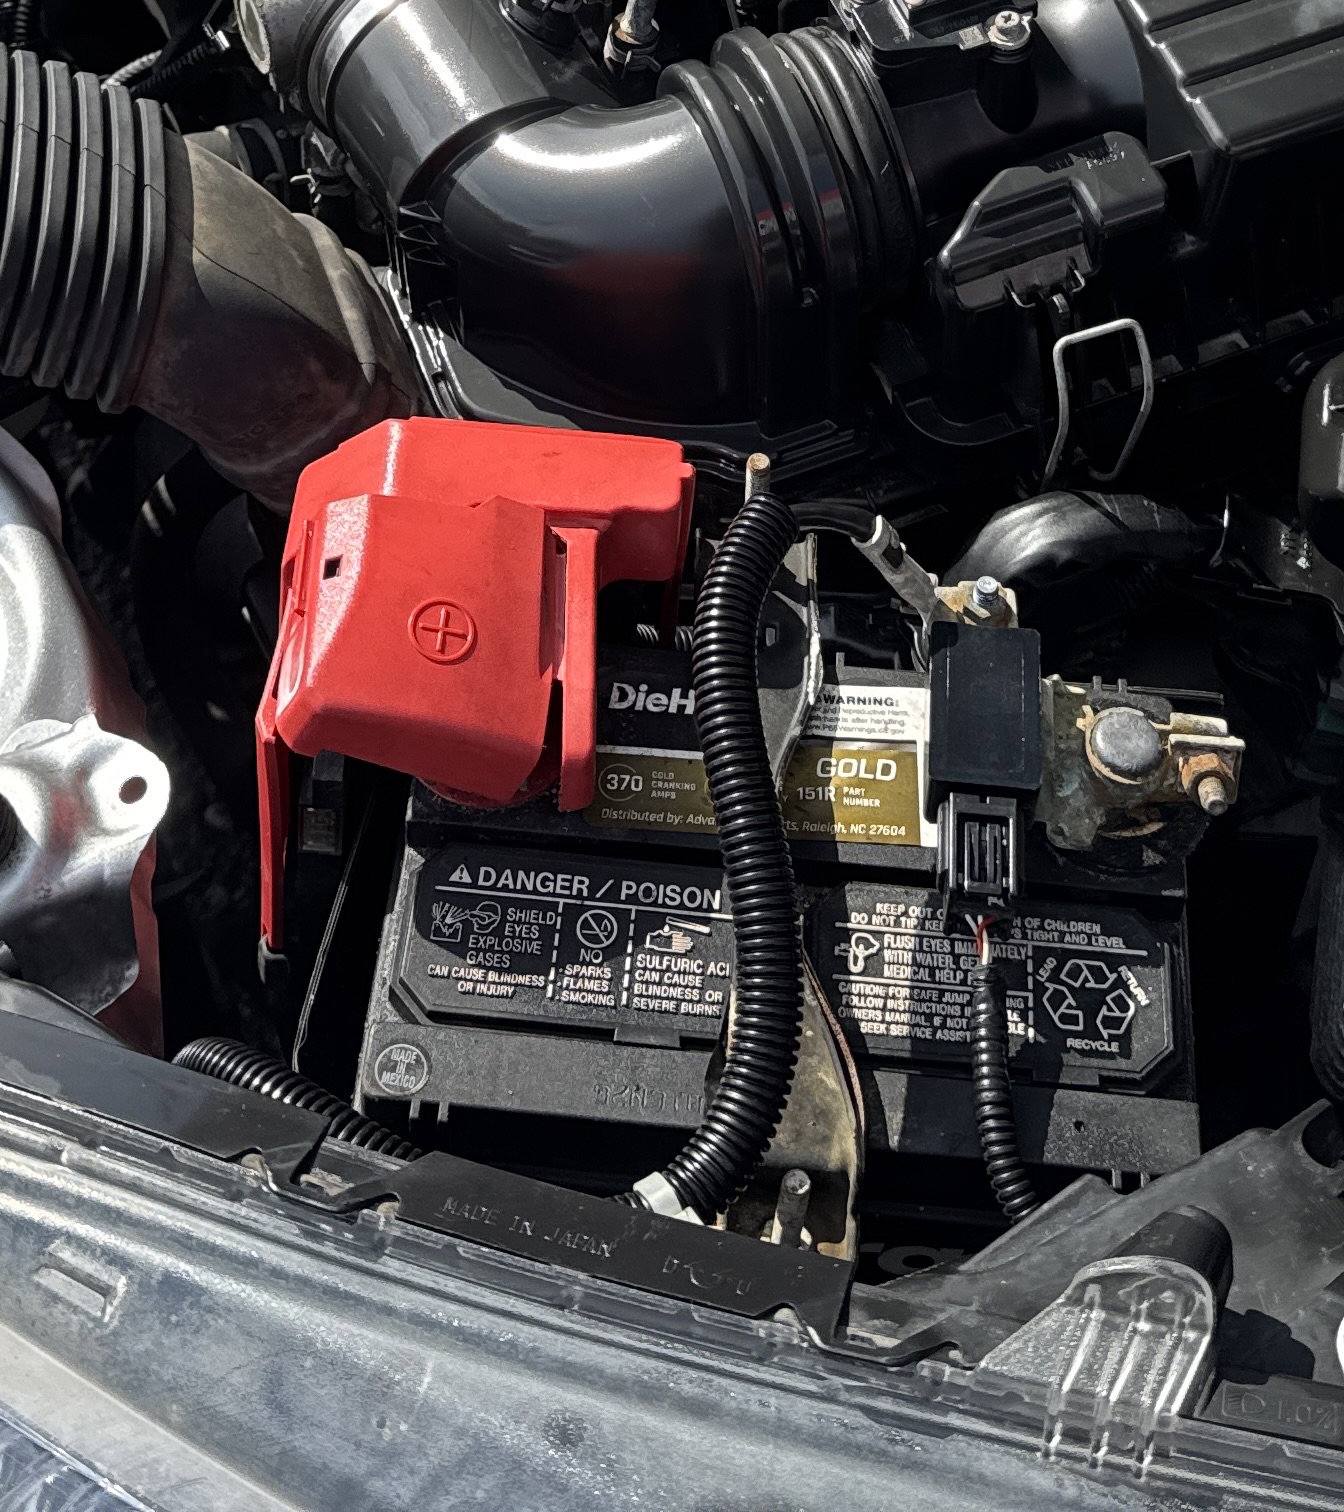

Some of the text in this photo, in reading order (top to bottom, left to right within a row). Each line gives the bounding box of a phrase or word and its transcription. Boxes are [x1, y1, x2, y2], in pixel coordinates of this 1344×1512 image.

[608, 681, 696, 715] DieH
[652, 770, 675, 780] COLD
[816, 757, 897, 781] GOLD
[606, 773, 643, 792] 370
[651, 780, 696, 791] CRANKING
[842, 786, 866, 797] PART
[650, 790, 676, 799] AMPS
[796, 785, 836, 802] 151R
[842, 796, 881, 808] NUMBER
[601, 808, 716, 826] Distributed by: Adva
[849, 823, 867, 835] NC
[869, 824, 907, 837] 27604
[477, 866, 590, 897] DANGER
[620, 880, 722, 910] POISON
[506, 907, 556, 926] SHIELD
[851, 912, 868, 925] DO
[871, 914, 896, 927] NOT
[876, 902, 906, 915] KEEP
[908, 905, 933, 919] OUT
[504, 923, 540, 939] EYES
[1024, 917, 1041, 928] OF
[1044, 918, 1101, 934] CHILDREN
[468, 934, 543, 955] EXPLOSIVE
[883, 933, 920, 950] FLUSH
[923, 936, 951, 952] EYES
[1027, 930, 1060, 942] TIGHT
[1063, 934, 1088, 945] AND
[1091, 935, 1127, 949] LEVEL
[466, 950, 511, 968] GASES
[579, 948, 603, 964] NO
[883, 949, 913, 965] WITH
[636, 954, 730, 977] SULFURIC ACI
[883, 964, 931, 981] MEDICAL
[935, 969, 964, 984] HELP
[1035, 956, 1057, 982] LEAD
[427, 964, 545, 987] CAN CAUSE BLINDNESS
[634, 970, 704, 987] CAN CAUSE
[457, 981, 514, 998] OR INJURY
[633, 983, 723, 1002] BLINDNESS OR
[1117, 964, 1150, 1007] RETURN
[841, 995, 885, 1009] FOLLOW
[886, 998, 962, 1014] INSTRUCTIONS
[888, 986, 910, 998] FOR
[913, 989, 939, 1001] SAFE
[942, 991, 971, 1005] JUMP
[632, 997, 677, 1013] SEVERE
[838, 1006, 882, 1020] OWNERS
[933, 1015, 944, 1025] IF
[946, 1016, 968, 1029] NOT
[860, 1021, 971, 1042] SEEK SERVICE ASSIST
[1066, 1038, 1120, 1053] RECYCLE
[391, 1048, 417, 1064] MADE
[396, 1060, 406, 1075] IN
[381, 1071, 416, 1088] MEXICO
[441, 1196, 498, 1225] MADE
[508, 1215, 534, 1236] IN
[543, 1226, 617, 1258] JAPAN
